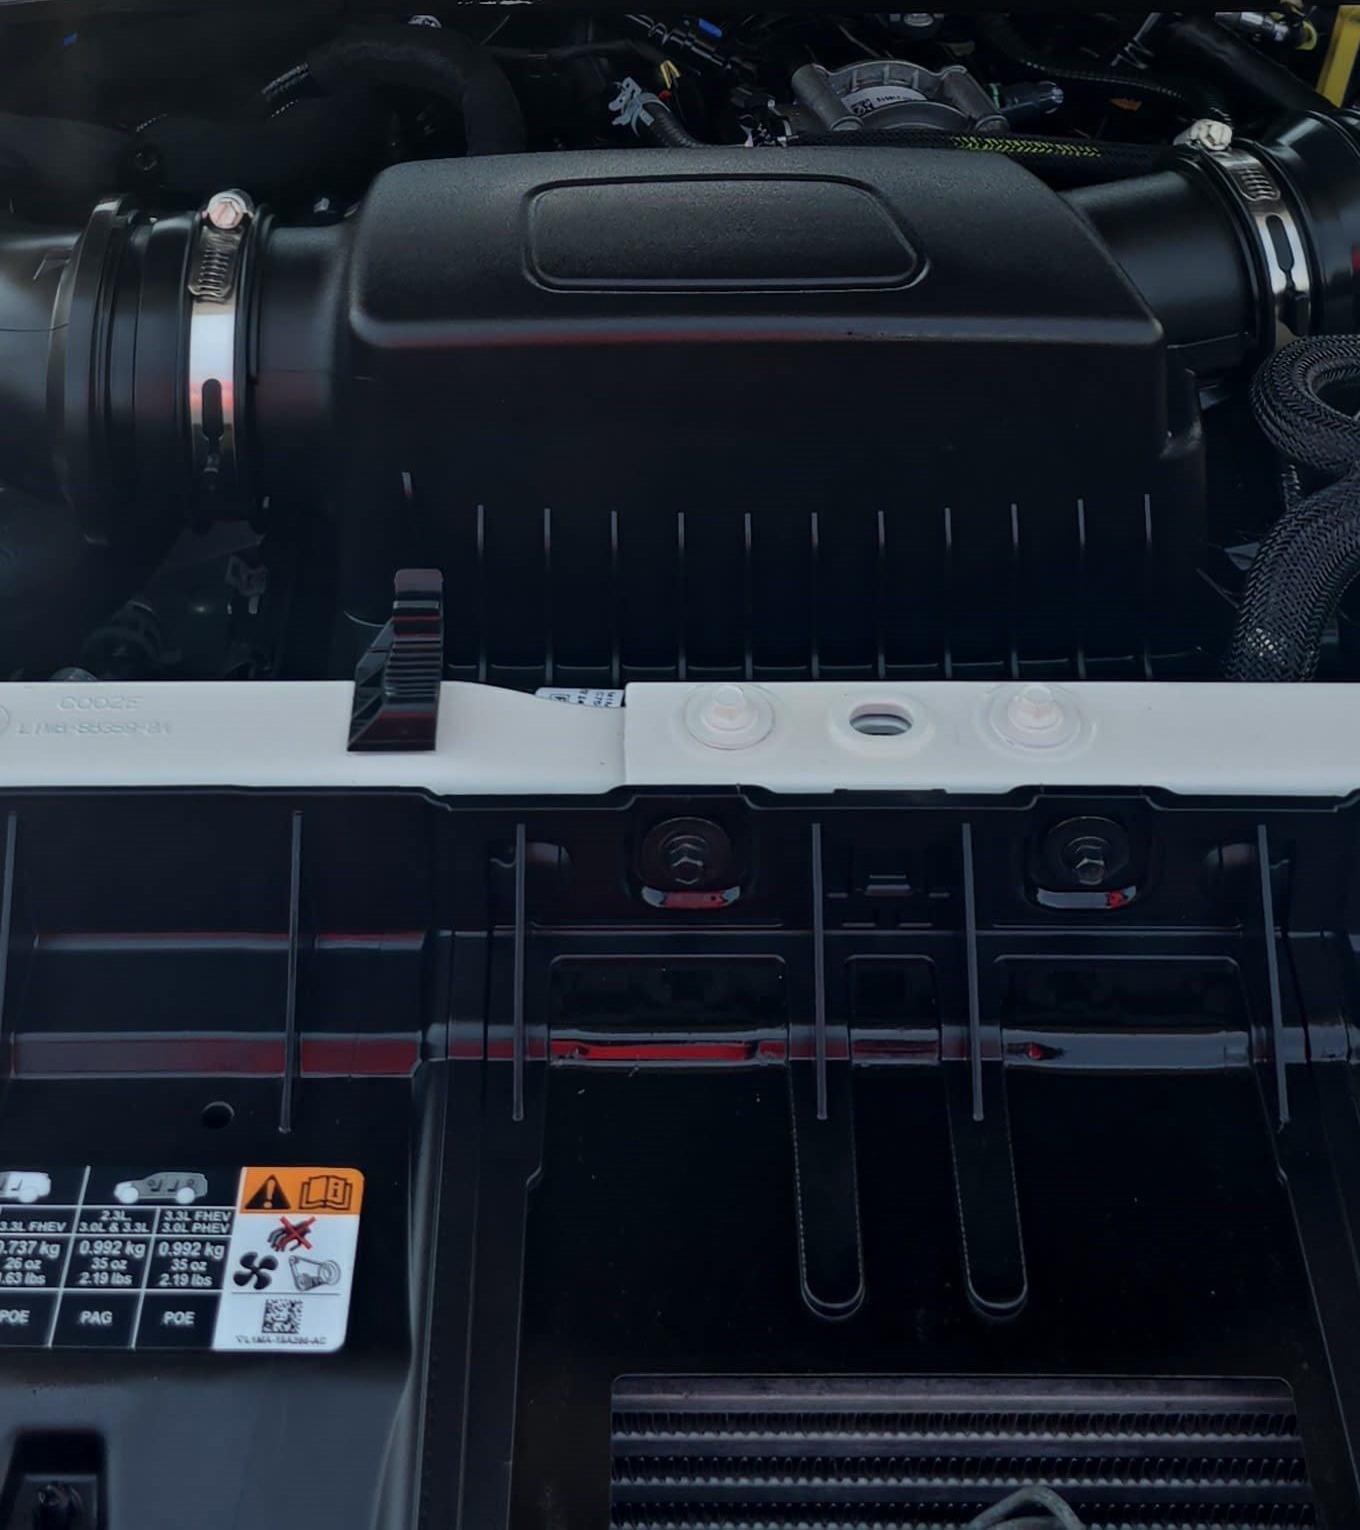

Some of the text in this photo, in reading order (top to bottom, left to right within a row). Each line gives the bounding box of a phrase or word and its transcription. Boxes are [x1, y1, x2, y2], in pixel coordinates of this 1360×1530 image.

[163, 1210, 232, 1222] 3.3L FHEV
[27, 1221, 67, 1232] FHEV
[78, 1222, 150, 1233] 3.0L & 3.3L
[161, 1222, 230, 1234] 3.0L PHEV
[39, 1241, 61, 1259] kg
[78, 1240, 146, 1259] 0.992 kg
[158, 1241, 225, 1260] 0.992 kg
[4, 1257, 42, 1270] 26 oz
[90, 1257, 128, 1270] 35 oz
[170, 1258, 208, 1271] 35 oz
[24, 1272, 46, 1285] lbs
[78, 1272, 133, 1285] 2.19 lbs
[158, 1273, 213, 1287] 2.19 lbs
[79, 1310, 114, 1324] PAG
[162, 1311, 196, 1325] POE
